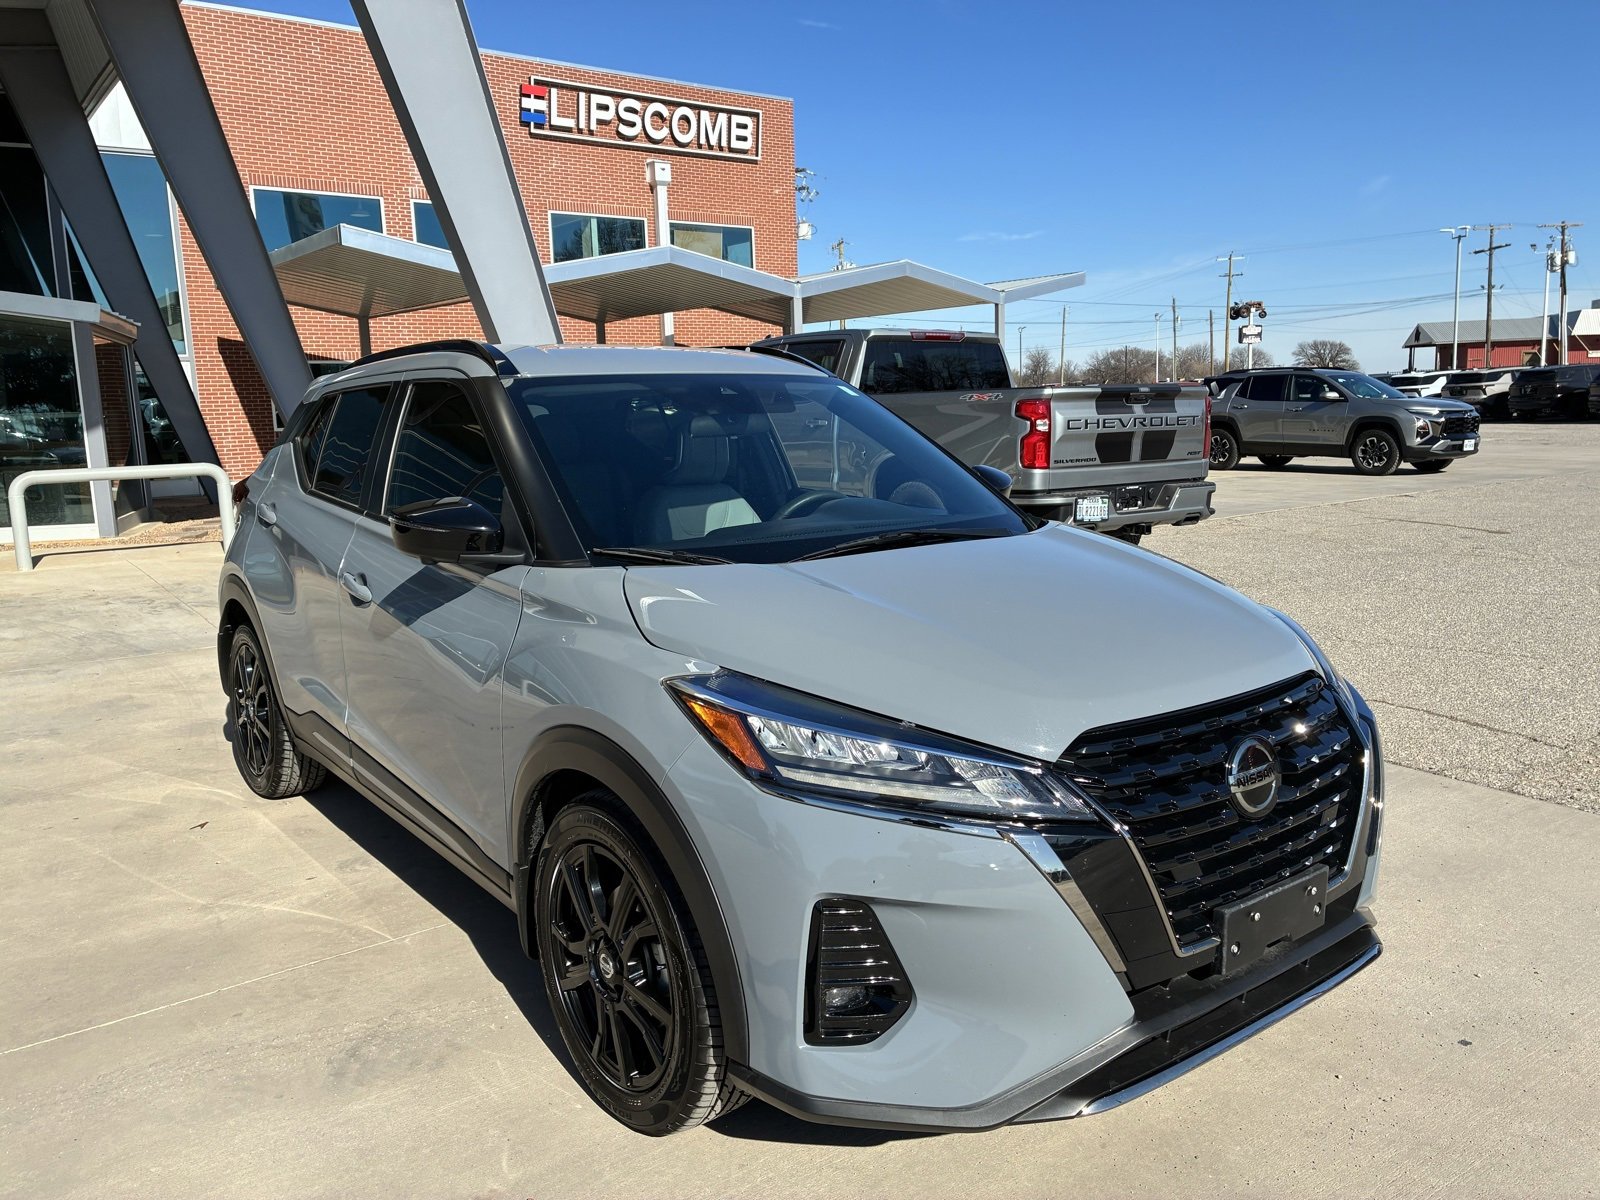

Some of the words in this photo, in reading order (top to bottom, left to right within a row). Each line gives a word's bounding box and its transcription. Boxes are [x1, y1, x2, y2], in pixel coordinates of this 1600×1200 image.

[550, 87, 754, 150] LIPSCOMB
[1067, 415, 1200, 431] CHEVROLET
[1053, 457, 1097, 465] SILVERADO
[1236, 767, 1274, 789] NISSAN
